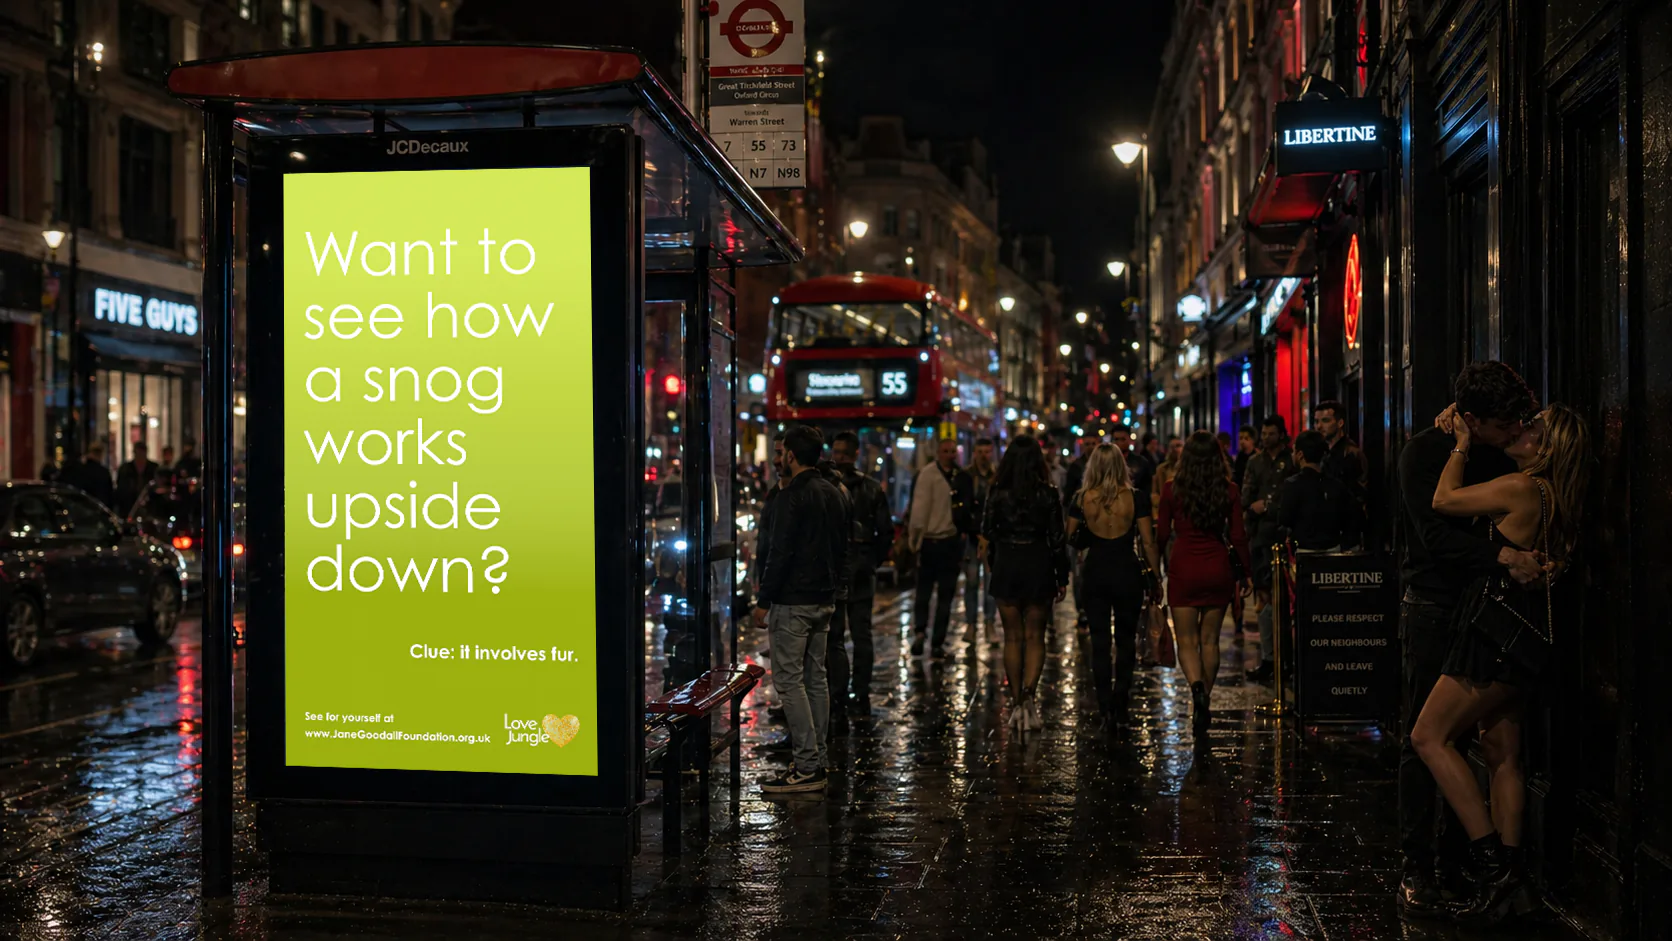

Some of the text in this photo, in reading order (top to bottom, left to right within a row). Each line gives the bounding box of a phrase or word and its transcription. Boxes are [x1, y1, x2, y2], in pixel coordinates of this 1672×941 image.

[718, 83, 738, 91] Great
[774, 81, 796, 89] Street
[729, 118, 785, 126] Warren Street
[1284, 126, 1376, 145] LIBERTINE
[386, 140, 469, 155] JCDecaux
[724, 140, 796, 152] 7 55 73
[750, 167, 801, 179] N7 N98
[305, 228, 536, 276] Want to
[94, 288, 198, 336] FIVE GUYS
[304, 291, 554, 339] see how
[306, 366, 502, 414] a snog
[881, 372, 908, 395] 55
[304, 418, 467, 466] works
[307, 480, 501, 540] upside
[307, 544, 509, 594] down?
[1311, 572, 1383, 584] LIBERTINE
[1312, 614, 1385, 623] PLEASE RESPECT
[1310, 638, 1387, 647] OUR NEIGHBOURS
[410, 643, 579, 662] Clue: it involves fur.
[1325, 662, 1373, 671] AND LEAVE
[1331, 686, 1368, 696] QUIETLY
[305, 711, 394, 724] See for yourself at
[504, 713, 538, 730] Love
[305, 729, 491, 745] www.JaneGoodallFoundation.org.uk
[506, 729, 550, 747] Jungle
